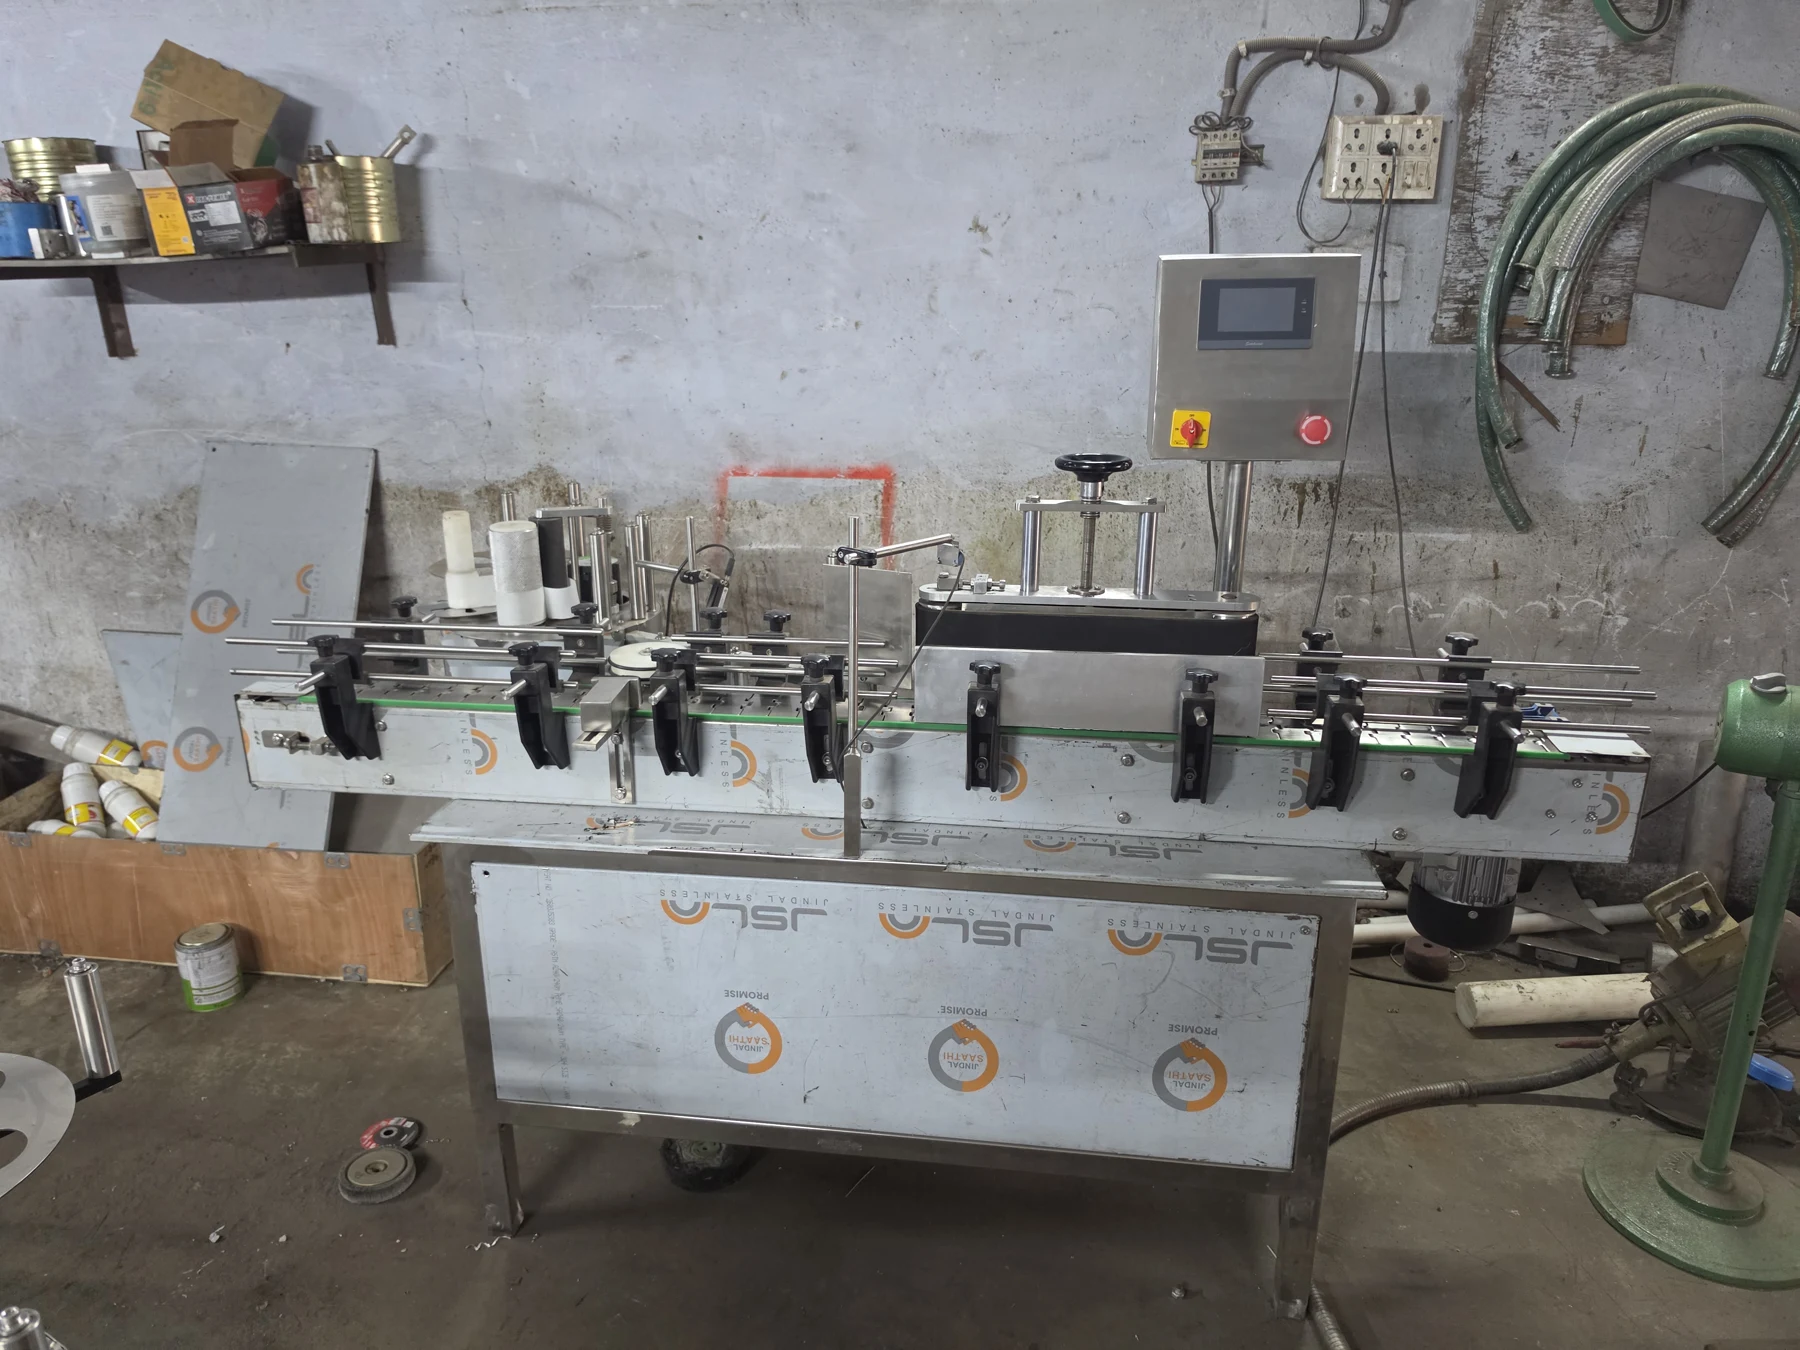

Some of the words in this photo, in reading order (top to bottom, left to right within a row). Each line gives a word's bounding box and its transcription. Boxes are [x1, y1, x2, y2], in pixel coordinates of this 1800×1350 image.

[459, 711, 473, 775] INLESS
[1276, 749, 1290, 819] INLESS
[636, 820, 751, 835] JSL
[1138, 840, 1203, 849] JINDAL
[1077, 843, 1203, 861] JSL
[659, 889, 752, 901] STAINLESS
[768, 895, 829, 907] JINDAL
[878, 902, 975, 916] STAINLESS
[991, 909, 1055, 922] JINDAL
[711, 902, 828, 932] JSL
[931, 916, 1054, 948] JSL
[1107, 918, 1210, 933] STAINLESS
[1227, 927, 1296, 940] JINDAL
[1163, 933, 1294, 966] JSL
[724, 989, 770, 1001] PROMISE
[940, 1005, 988, 1017] PROMISE
[1168, 1023, 1218, 1036] PROMISE
[728, 1034, 768, 1046] SAATHI
[733, 1043, 764, 1052] JINDAL
[943, 1051, 984, 1063] SAATHI
[947, 1060, 980, 1070] JINDAL
[1168, 1071, 1212, 1083] SAATHI
[1173, 1080, 1206, 1090] JINDAL
